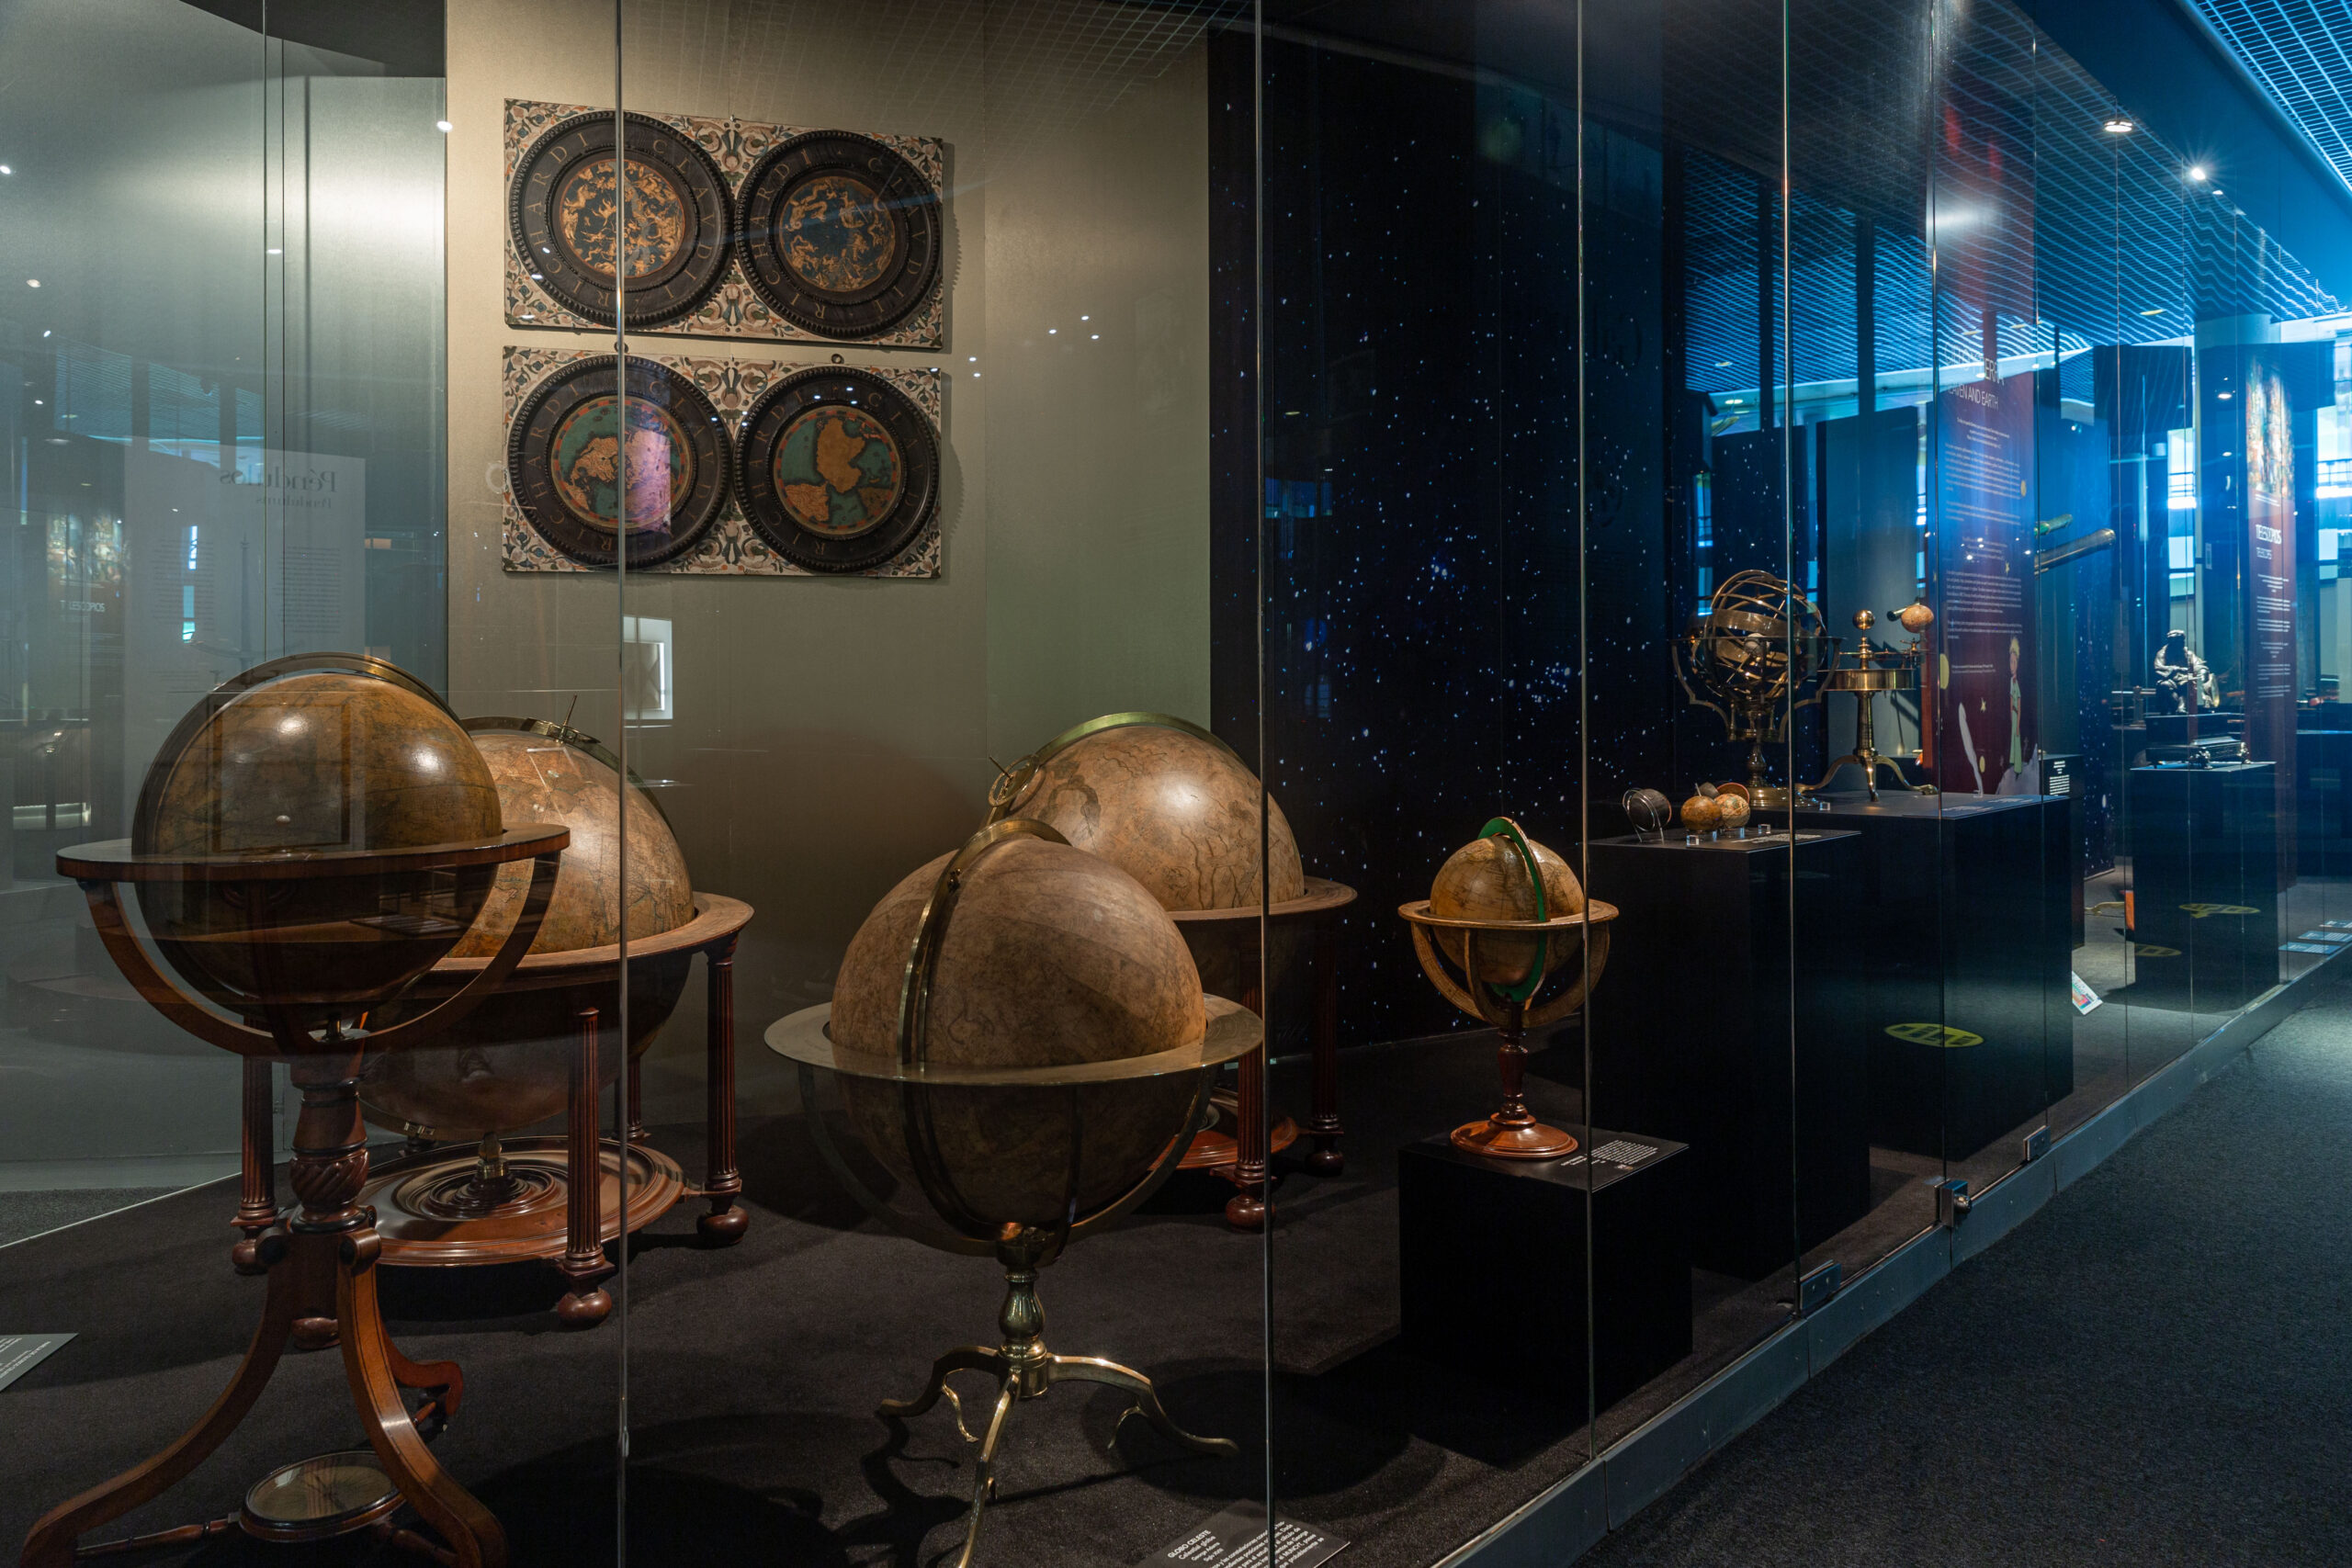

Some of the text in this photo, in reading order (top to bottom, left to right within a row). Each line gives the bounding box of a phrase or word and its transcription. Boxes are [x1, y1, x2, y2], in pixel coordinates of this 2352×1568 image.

[1968, 387, 1981, 404] AND
[1982, 390, 1999, 411] EARTH
[1168, 1529, 1212, 1559] GLOBO CELESTE
